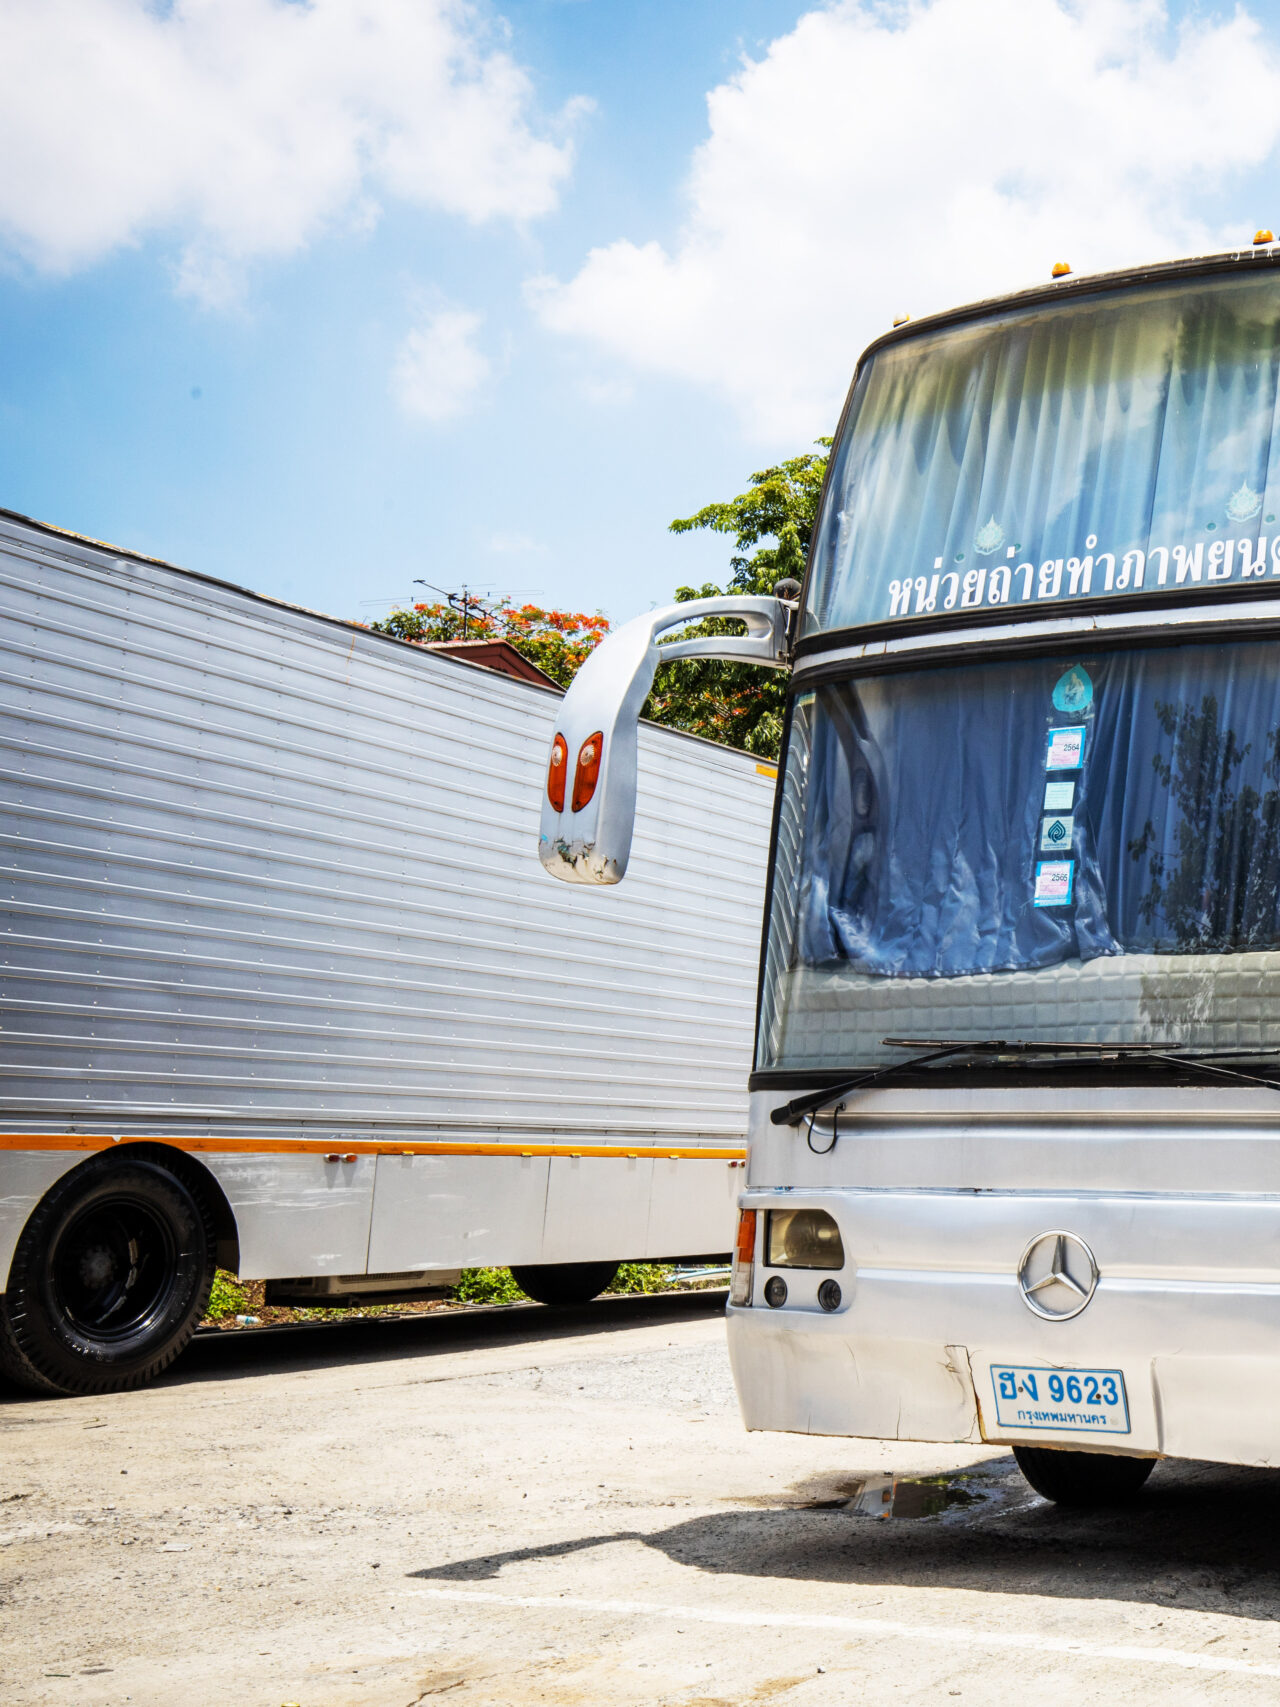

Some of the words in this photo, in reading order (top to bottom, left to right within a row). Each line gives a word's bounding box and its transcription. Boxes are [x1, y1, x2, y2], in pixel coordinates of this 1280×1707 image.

[1063, 743, 1080, 752] 2564
[1051, 873, 1069, 882] 2565
[1048, 1374, 1119, 1406] 9623
[1017, 1408, 1107, 1425] กรุงเทพมหานคร
